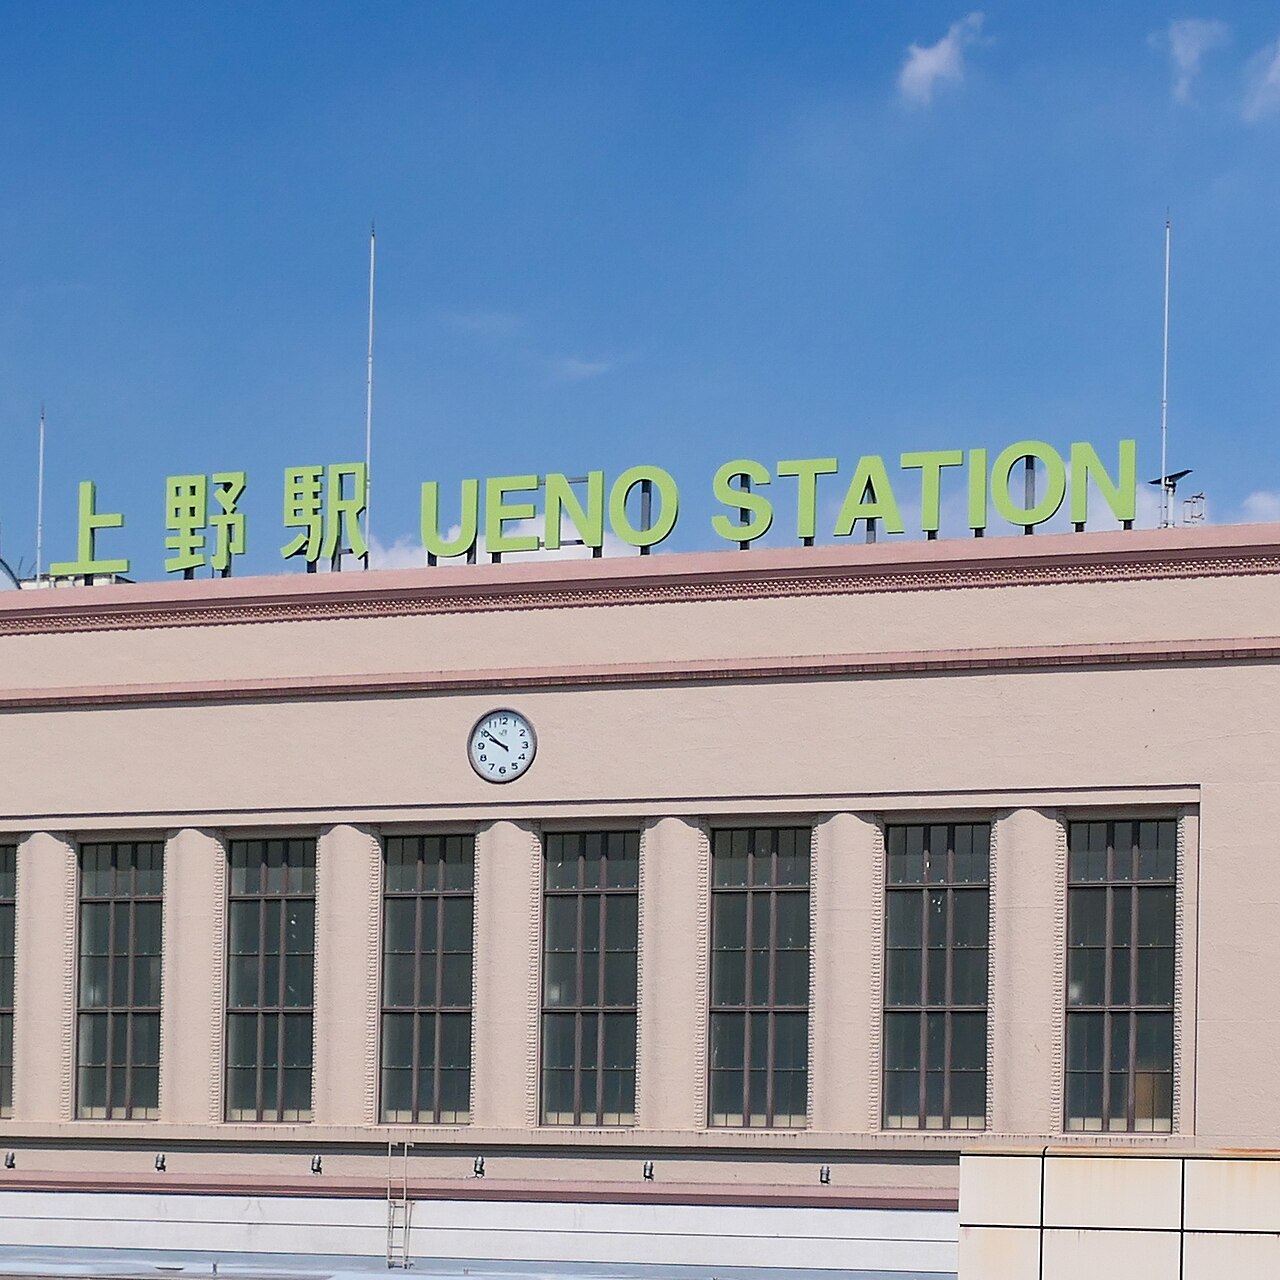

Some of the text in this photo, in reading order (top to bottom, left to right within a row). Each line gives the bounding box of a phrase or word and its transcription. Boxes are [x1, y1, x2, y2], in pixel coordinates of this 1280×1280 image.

[49, 439, 1136, 575] 上野駅 UENO STATION
[499, 717, 508, 725] 12
[520, 729, 526, 737] 2
[478, 742, 485, 750] 9
[522, 741, 529, 749] 3
[480, 754, 487, 762] 8
[489, 763, 496, 771] 7
[499, 766, 507, 774] 6
[512, 762, 519, 770] 5
